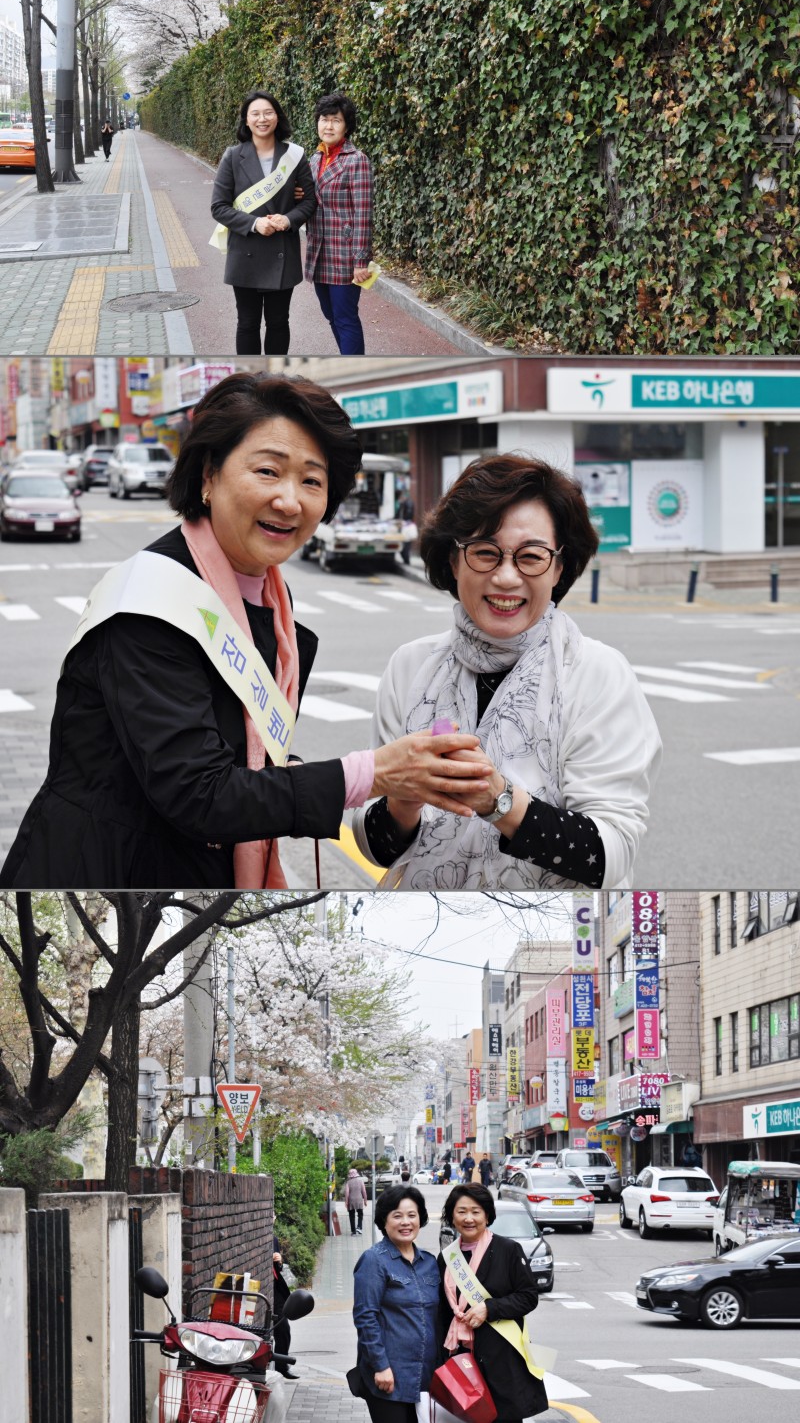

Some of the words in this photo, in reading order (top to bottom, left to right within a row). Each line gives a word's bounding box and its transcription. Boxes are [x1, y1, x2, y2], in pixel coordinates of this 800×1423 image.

[641, 380, 680, 401] KEB
[683, 380, 754, 405] 하나은행
[575, 983, 592, 1021] 전당포
[576, 1037, 592, 1070] 부동산
[509, 1049, 517, 1092] 한강부동산
[643, 1077, 665, 1085] 7080
[229, 1092, 249, 1104] 양보
[769, 1110, 783, 1126] KEB
